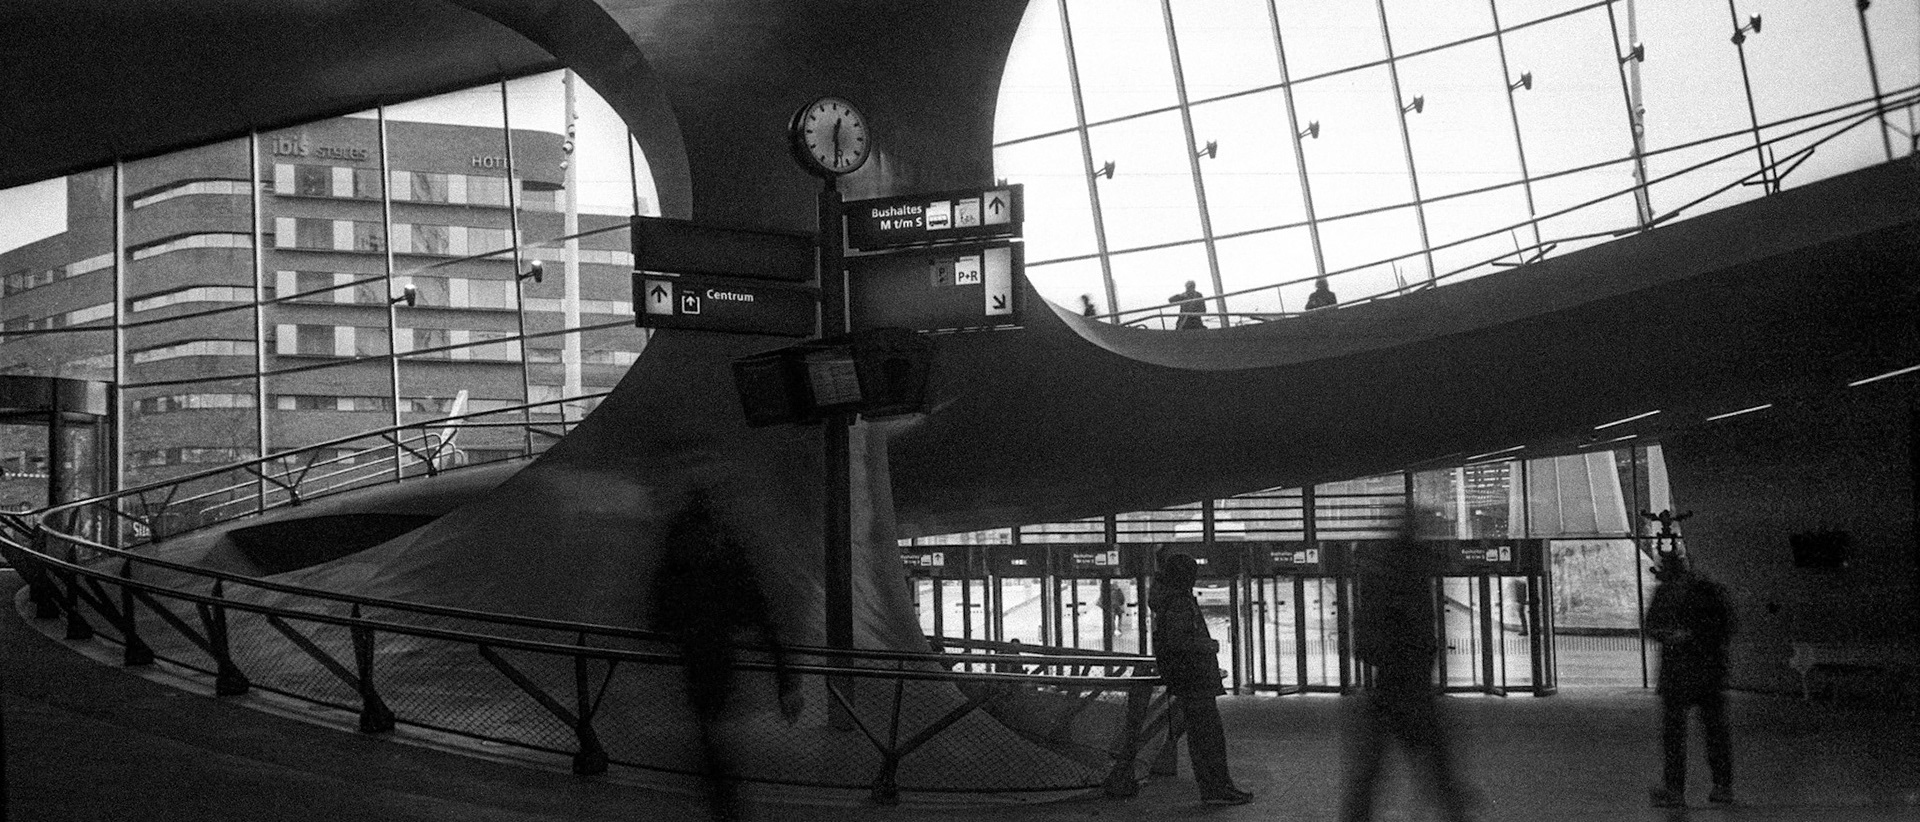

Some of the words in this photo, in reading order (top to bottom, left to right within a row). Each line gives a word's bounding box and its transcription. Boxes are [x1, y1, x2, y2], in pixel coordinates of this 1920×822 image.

[272, 134, 309, 156] ibis
[871, 204, 923, 218] Bushaltes
[880, 220, 891, 231] M
[894, 218, 913, 228] t/m
[915, 216, 923, 227] S
[958, 270, 978, 282] P+R
[706, 288, 754, 302] Centrum
